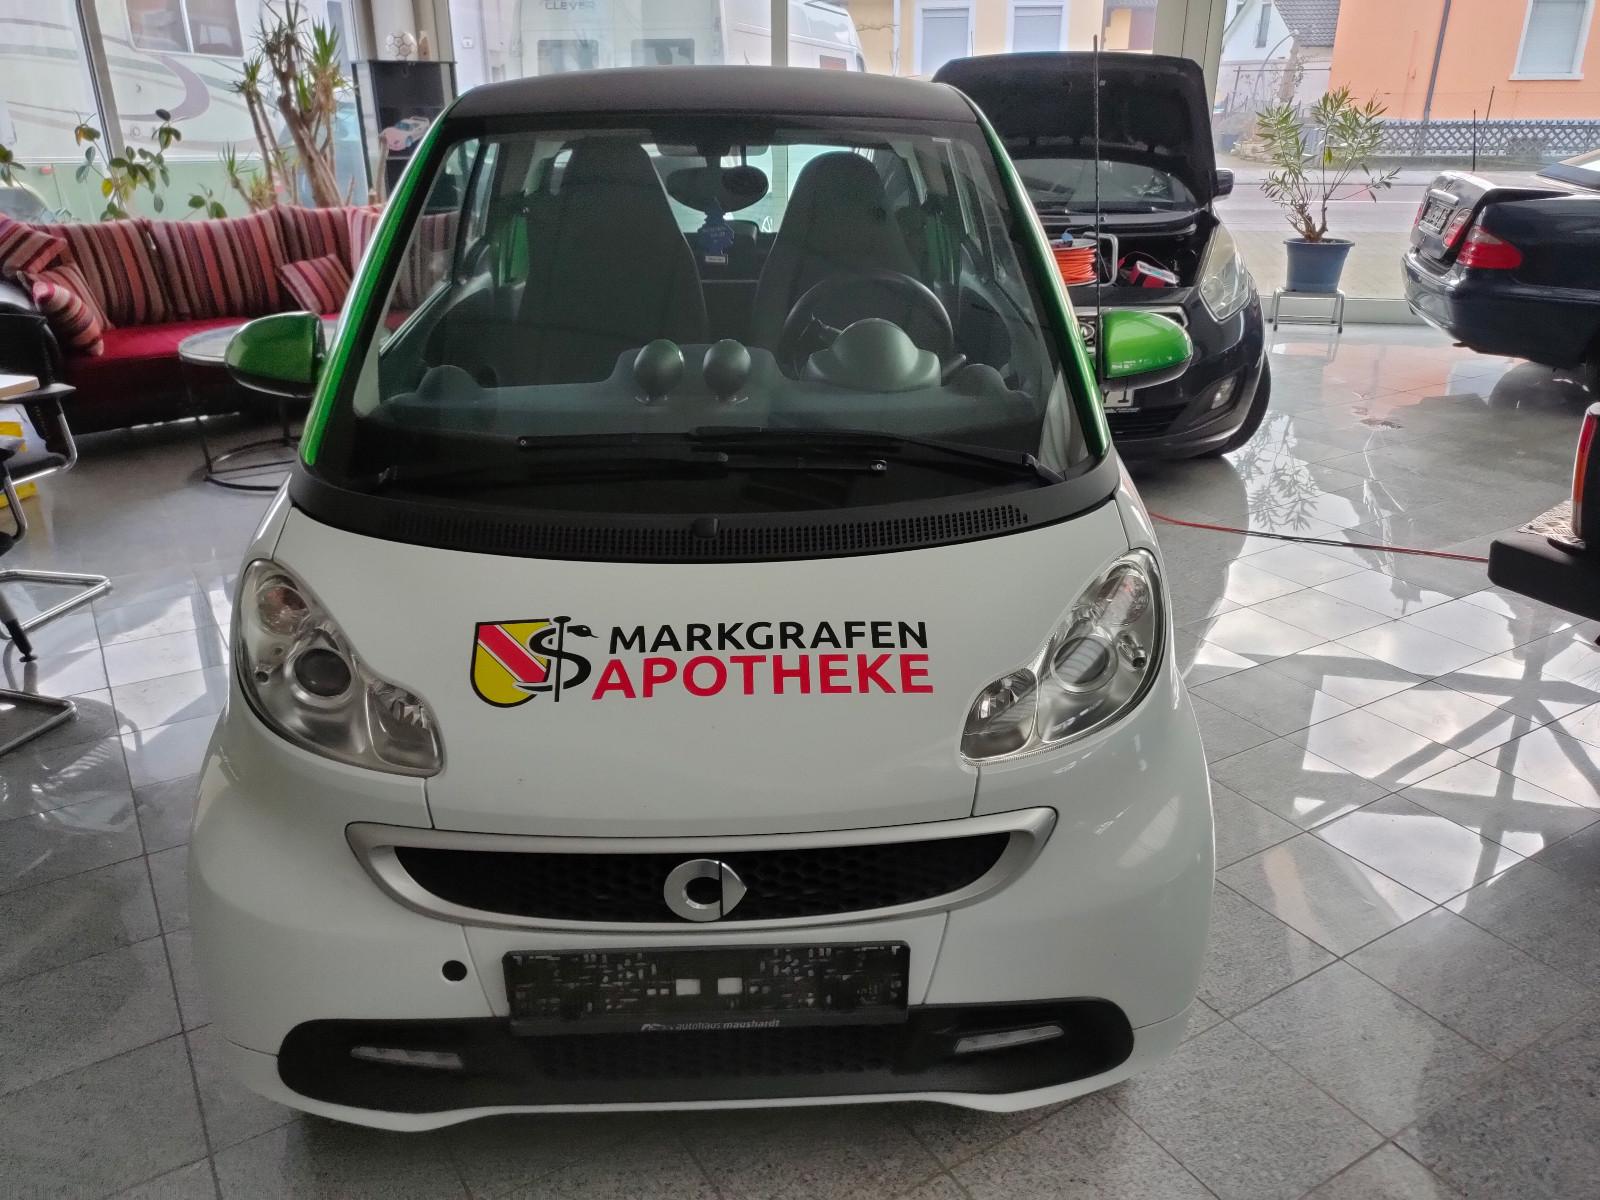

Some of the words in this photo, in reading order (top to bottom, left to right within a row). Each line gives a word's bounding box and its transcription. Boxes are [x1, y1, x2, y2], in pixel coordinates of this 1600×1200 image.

[609, 622, 928, 654] MARKGRAFEN
[592, 653, 934, 700] APOTHEKE
[675, 1021, 721, 1031] autohaus
[723, 1019, 781, 1030] maushardt
